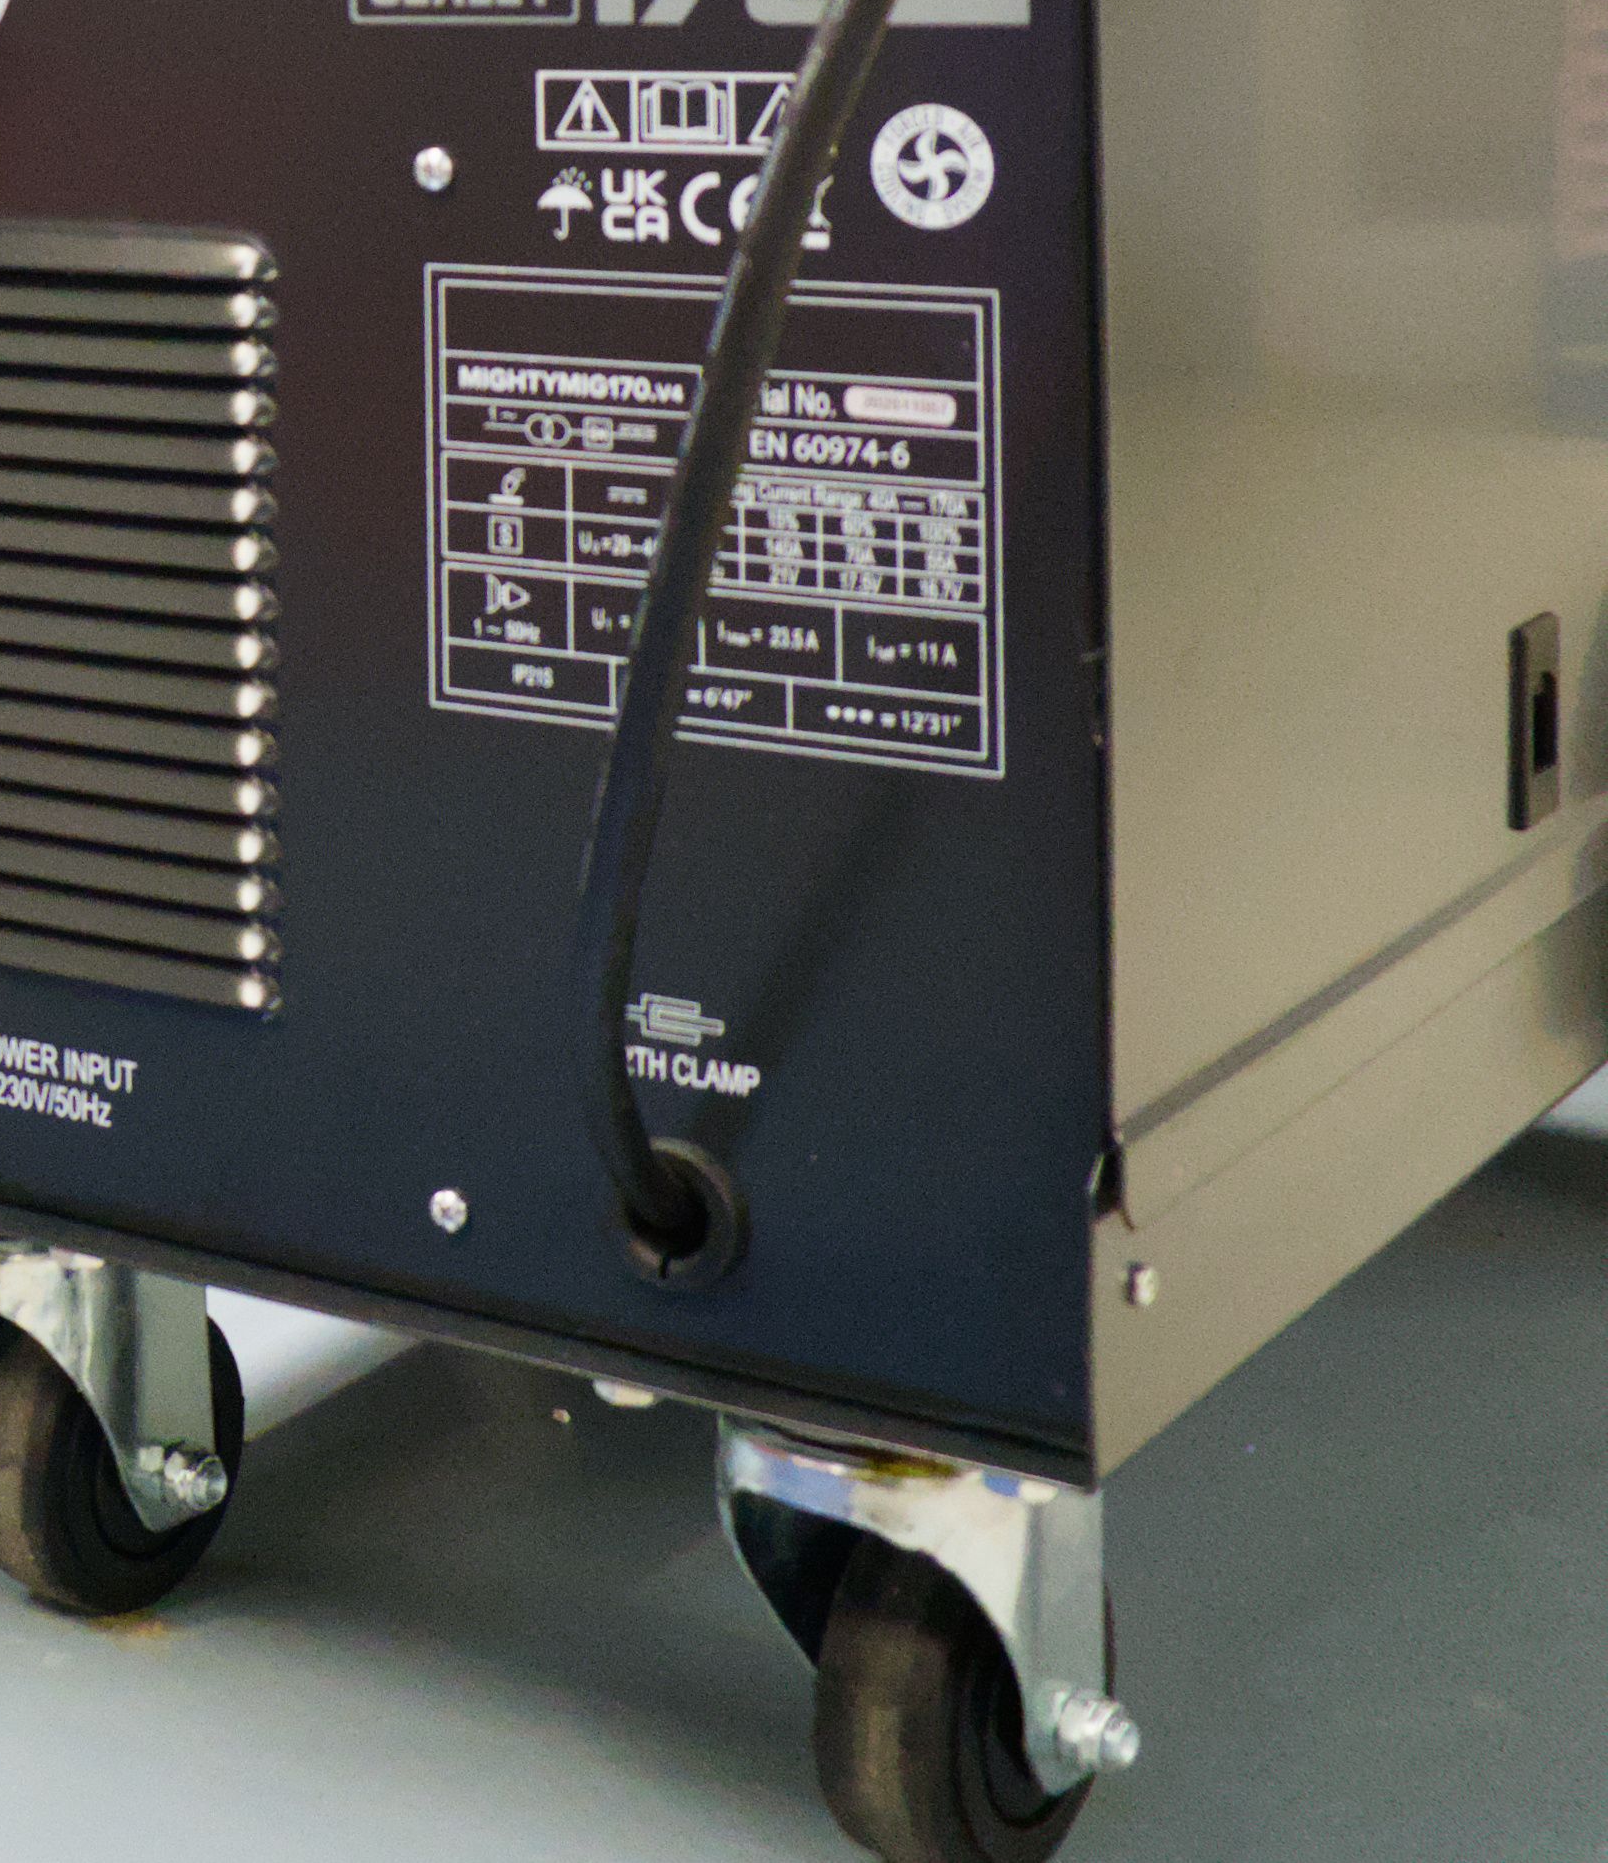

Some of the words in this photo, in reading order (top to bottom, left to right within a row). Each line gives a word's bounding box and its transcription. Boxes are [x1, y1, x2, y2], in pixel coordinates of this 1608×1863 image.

[601, 168, 668, 207] UK
[601, 205, 669, 242] CA
[794, 383, 837, 420] No.
[749, 428, 788, 460] EN
[792, 433, 911, 470] 60974-6
[757, 481, 811, 503] Current
[63, 1047, 139, 1094] INPUT
[671, 1052, 761, 1098] CLAMP
